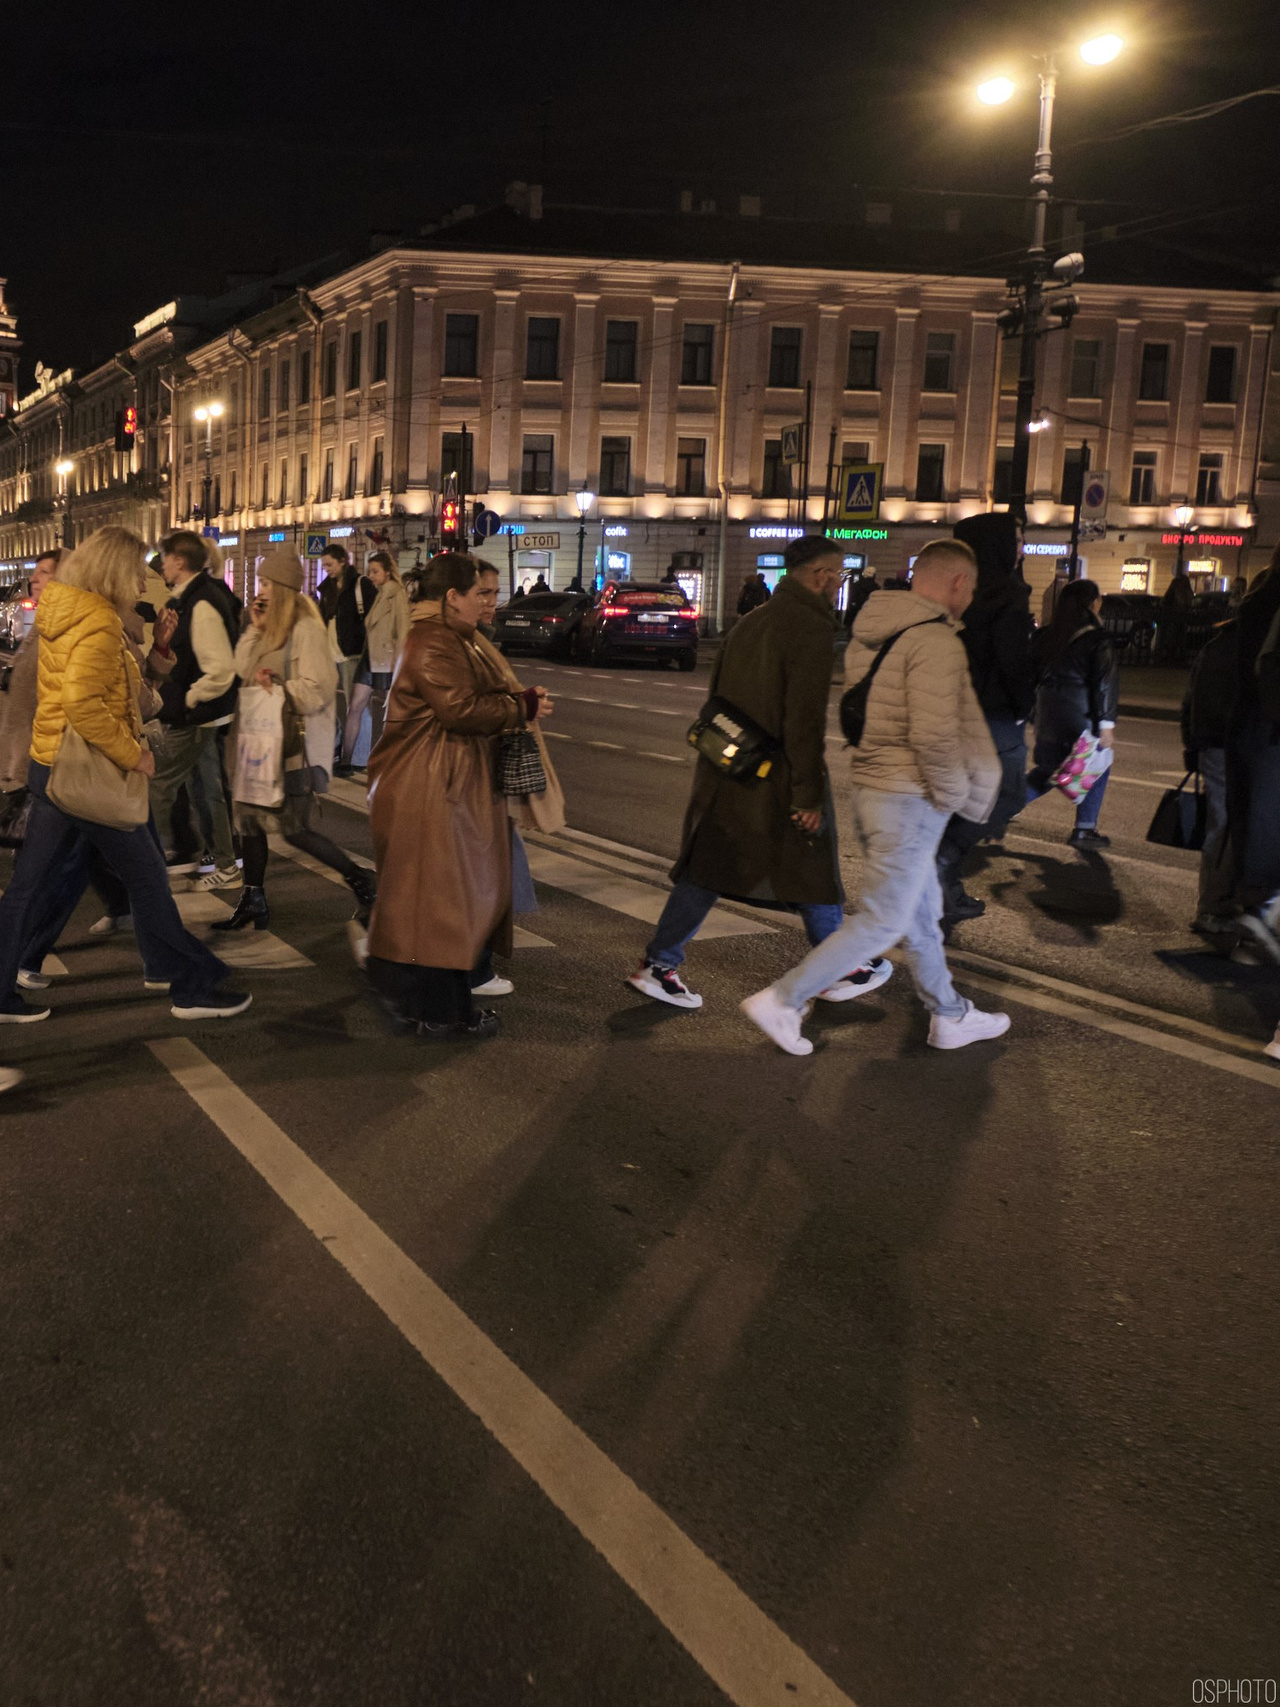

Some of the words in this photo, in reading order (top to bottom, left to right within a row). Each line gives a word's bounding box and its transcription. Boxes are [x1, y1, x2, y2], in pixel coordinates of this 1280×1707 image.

[444, 519, 455, 530] 24
[605, 526, 627, 536] cofix
[756, 528, 787, 538] COFFEE
[524, 535, 554, 547] СТОП
[1198, 534, 1243, 546] ПРОДУКТЫ
